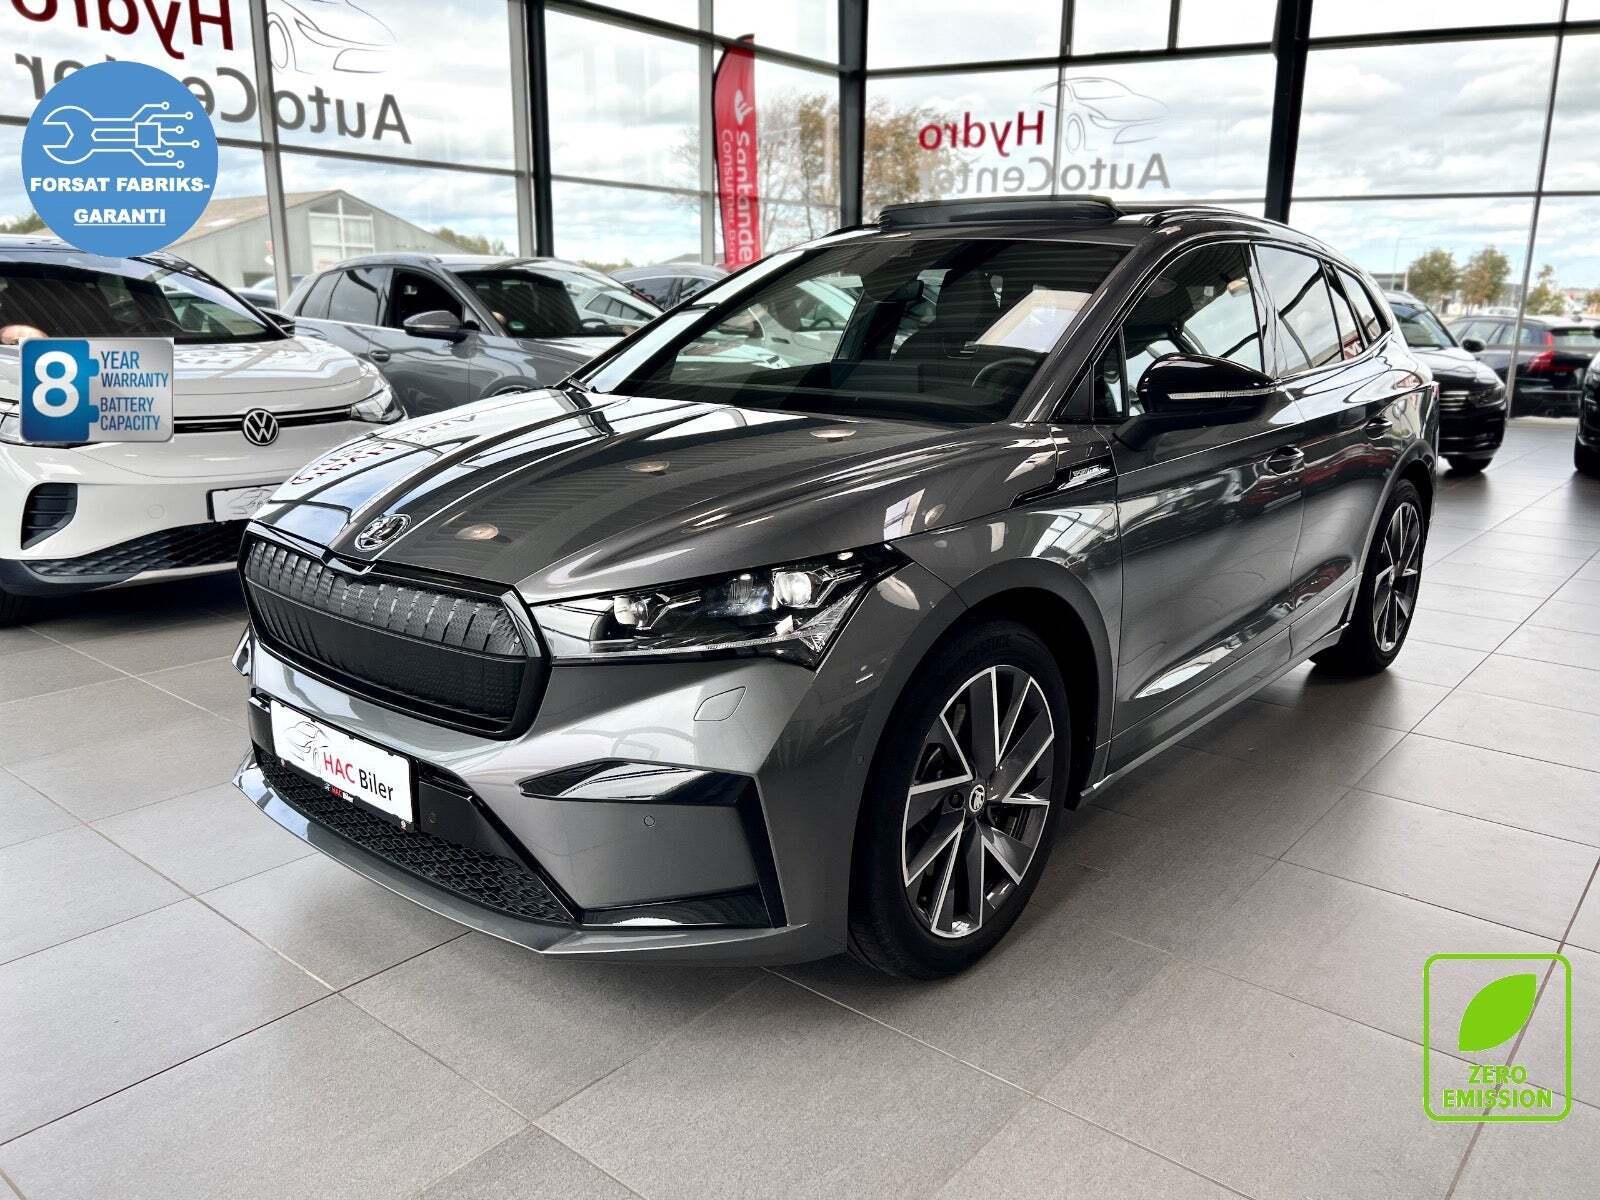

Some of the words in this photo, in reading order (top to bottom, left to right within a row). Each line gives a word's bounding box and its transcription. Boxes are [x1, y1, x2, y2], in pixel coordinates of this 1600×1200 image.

[721, 129, 736, 224] Consumer
[736, 130, 755, 262] Santande
[728, 229, 736, 265] Ban
[323, 751, 355, 784] HAC
[358, 768, 393, 801] Biler
